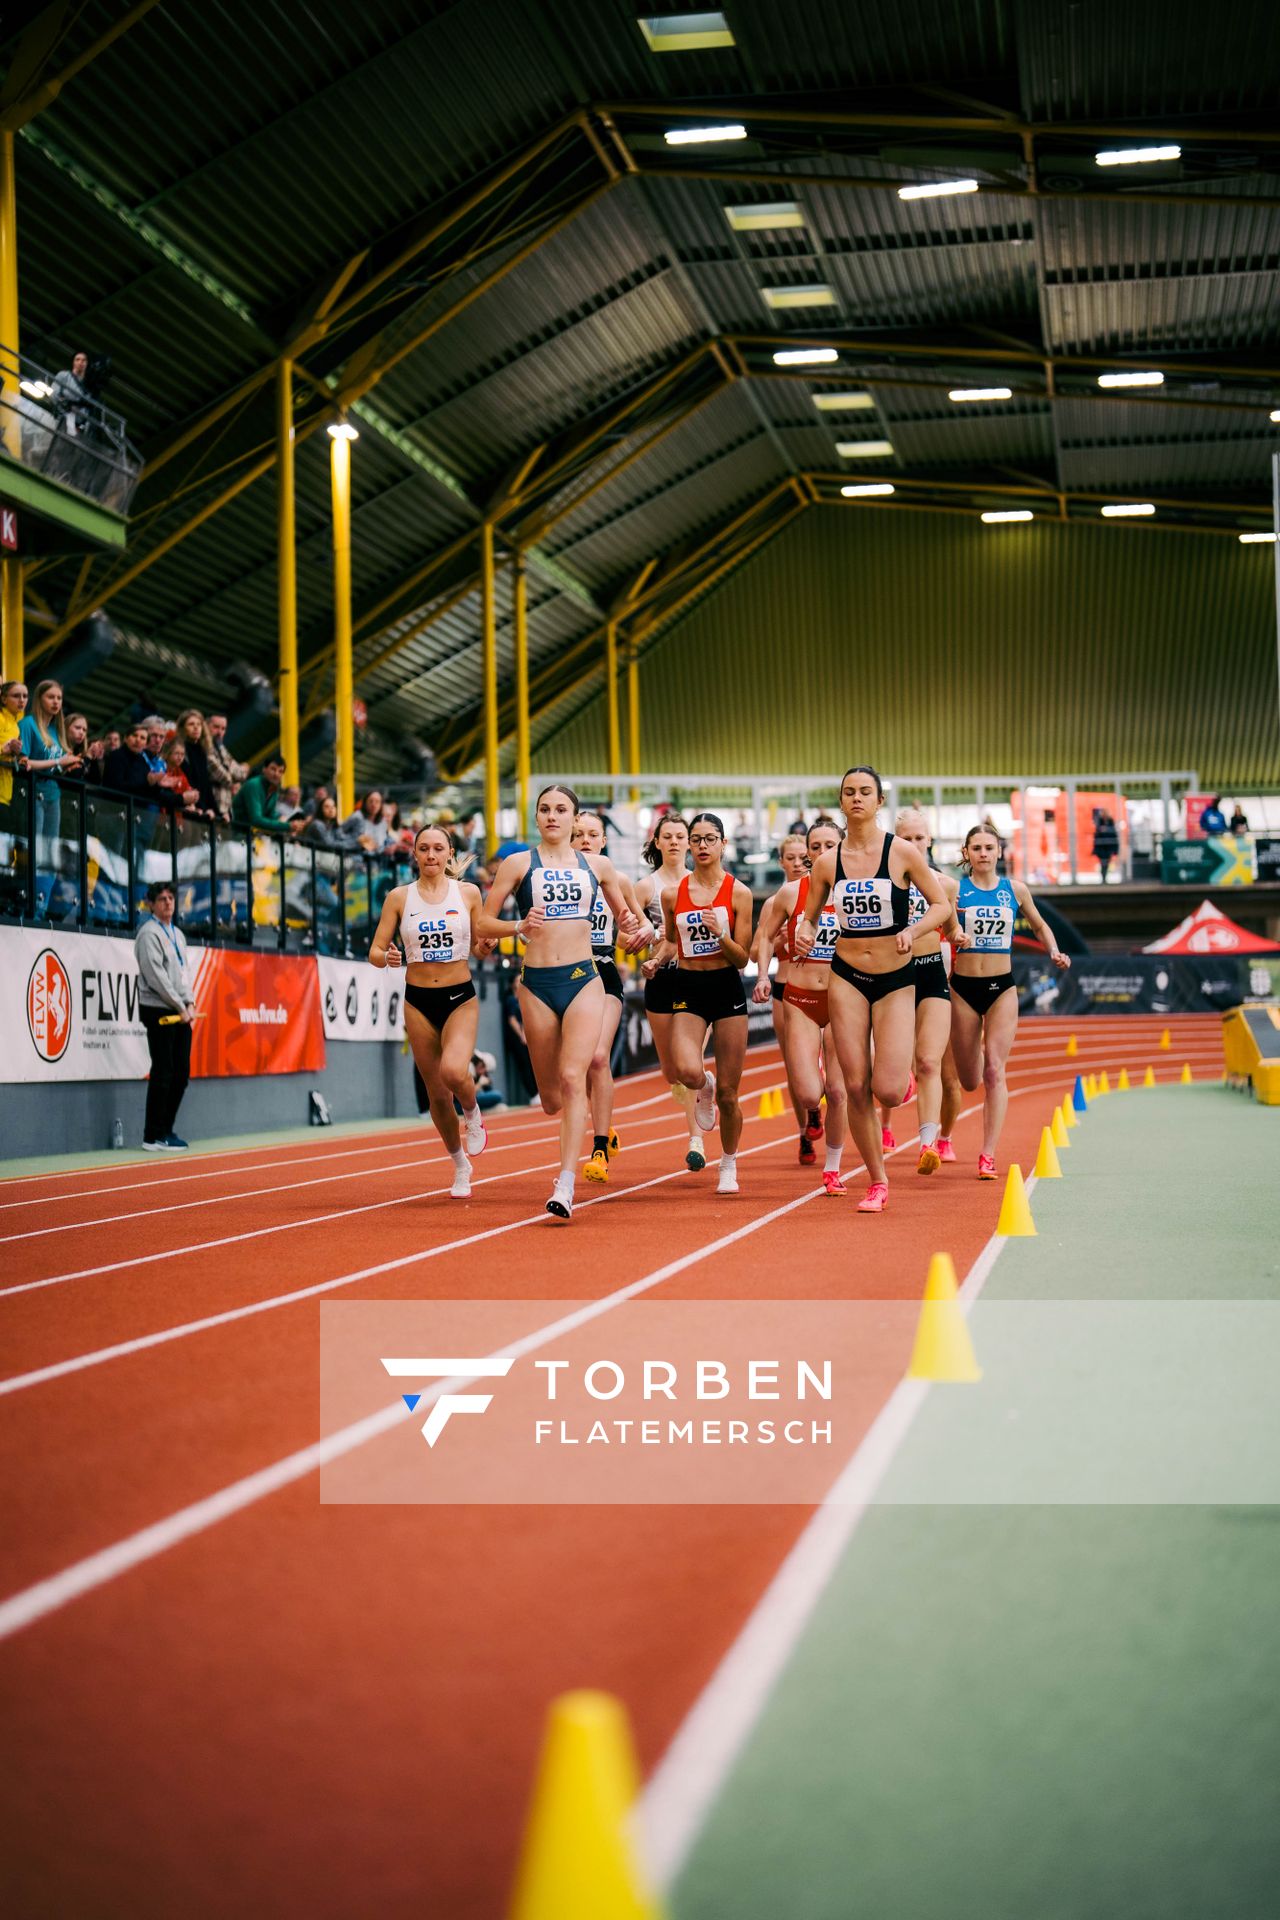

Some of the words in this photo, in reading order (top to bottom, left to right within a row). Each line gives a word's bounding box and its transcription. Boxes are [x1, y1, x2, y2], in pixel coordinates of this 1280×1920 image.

[3, 510, 15, 543] K
[543, 870, 573, 881] GLS
[543, 883, 582, 902] 335
[846, 881, 874, 893] GLS
[842, 895, 882, 914] 556
[687, 913, 703, 924] GL
[976, 908, 1000, 918] GLS
[418, 920, 446, 932] GLS
[818, 916, 835, 927] LS
[974, 920, 1005, 935] 372
[418, 932, 454, 949] 235
[687, 925, 717, 942] 29
[816, 929, 841, 946] 42
[915, 955, 941, 966] NIKE
[36, 972, 45, 1039] FLVW
